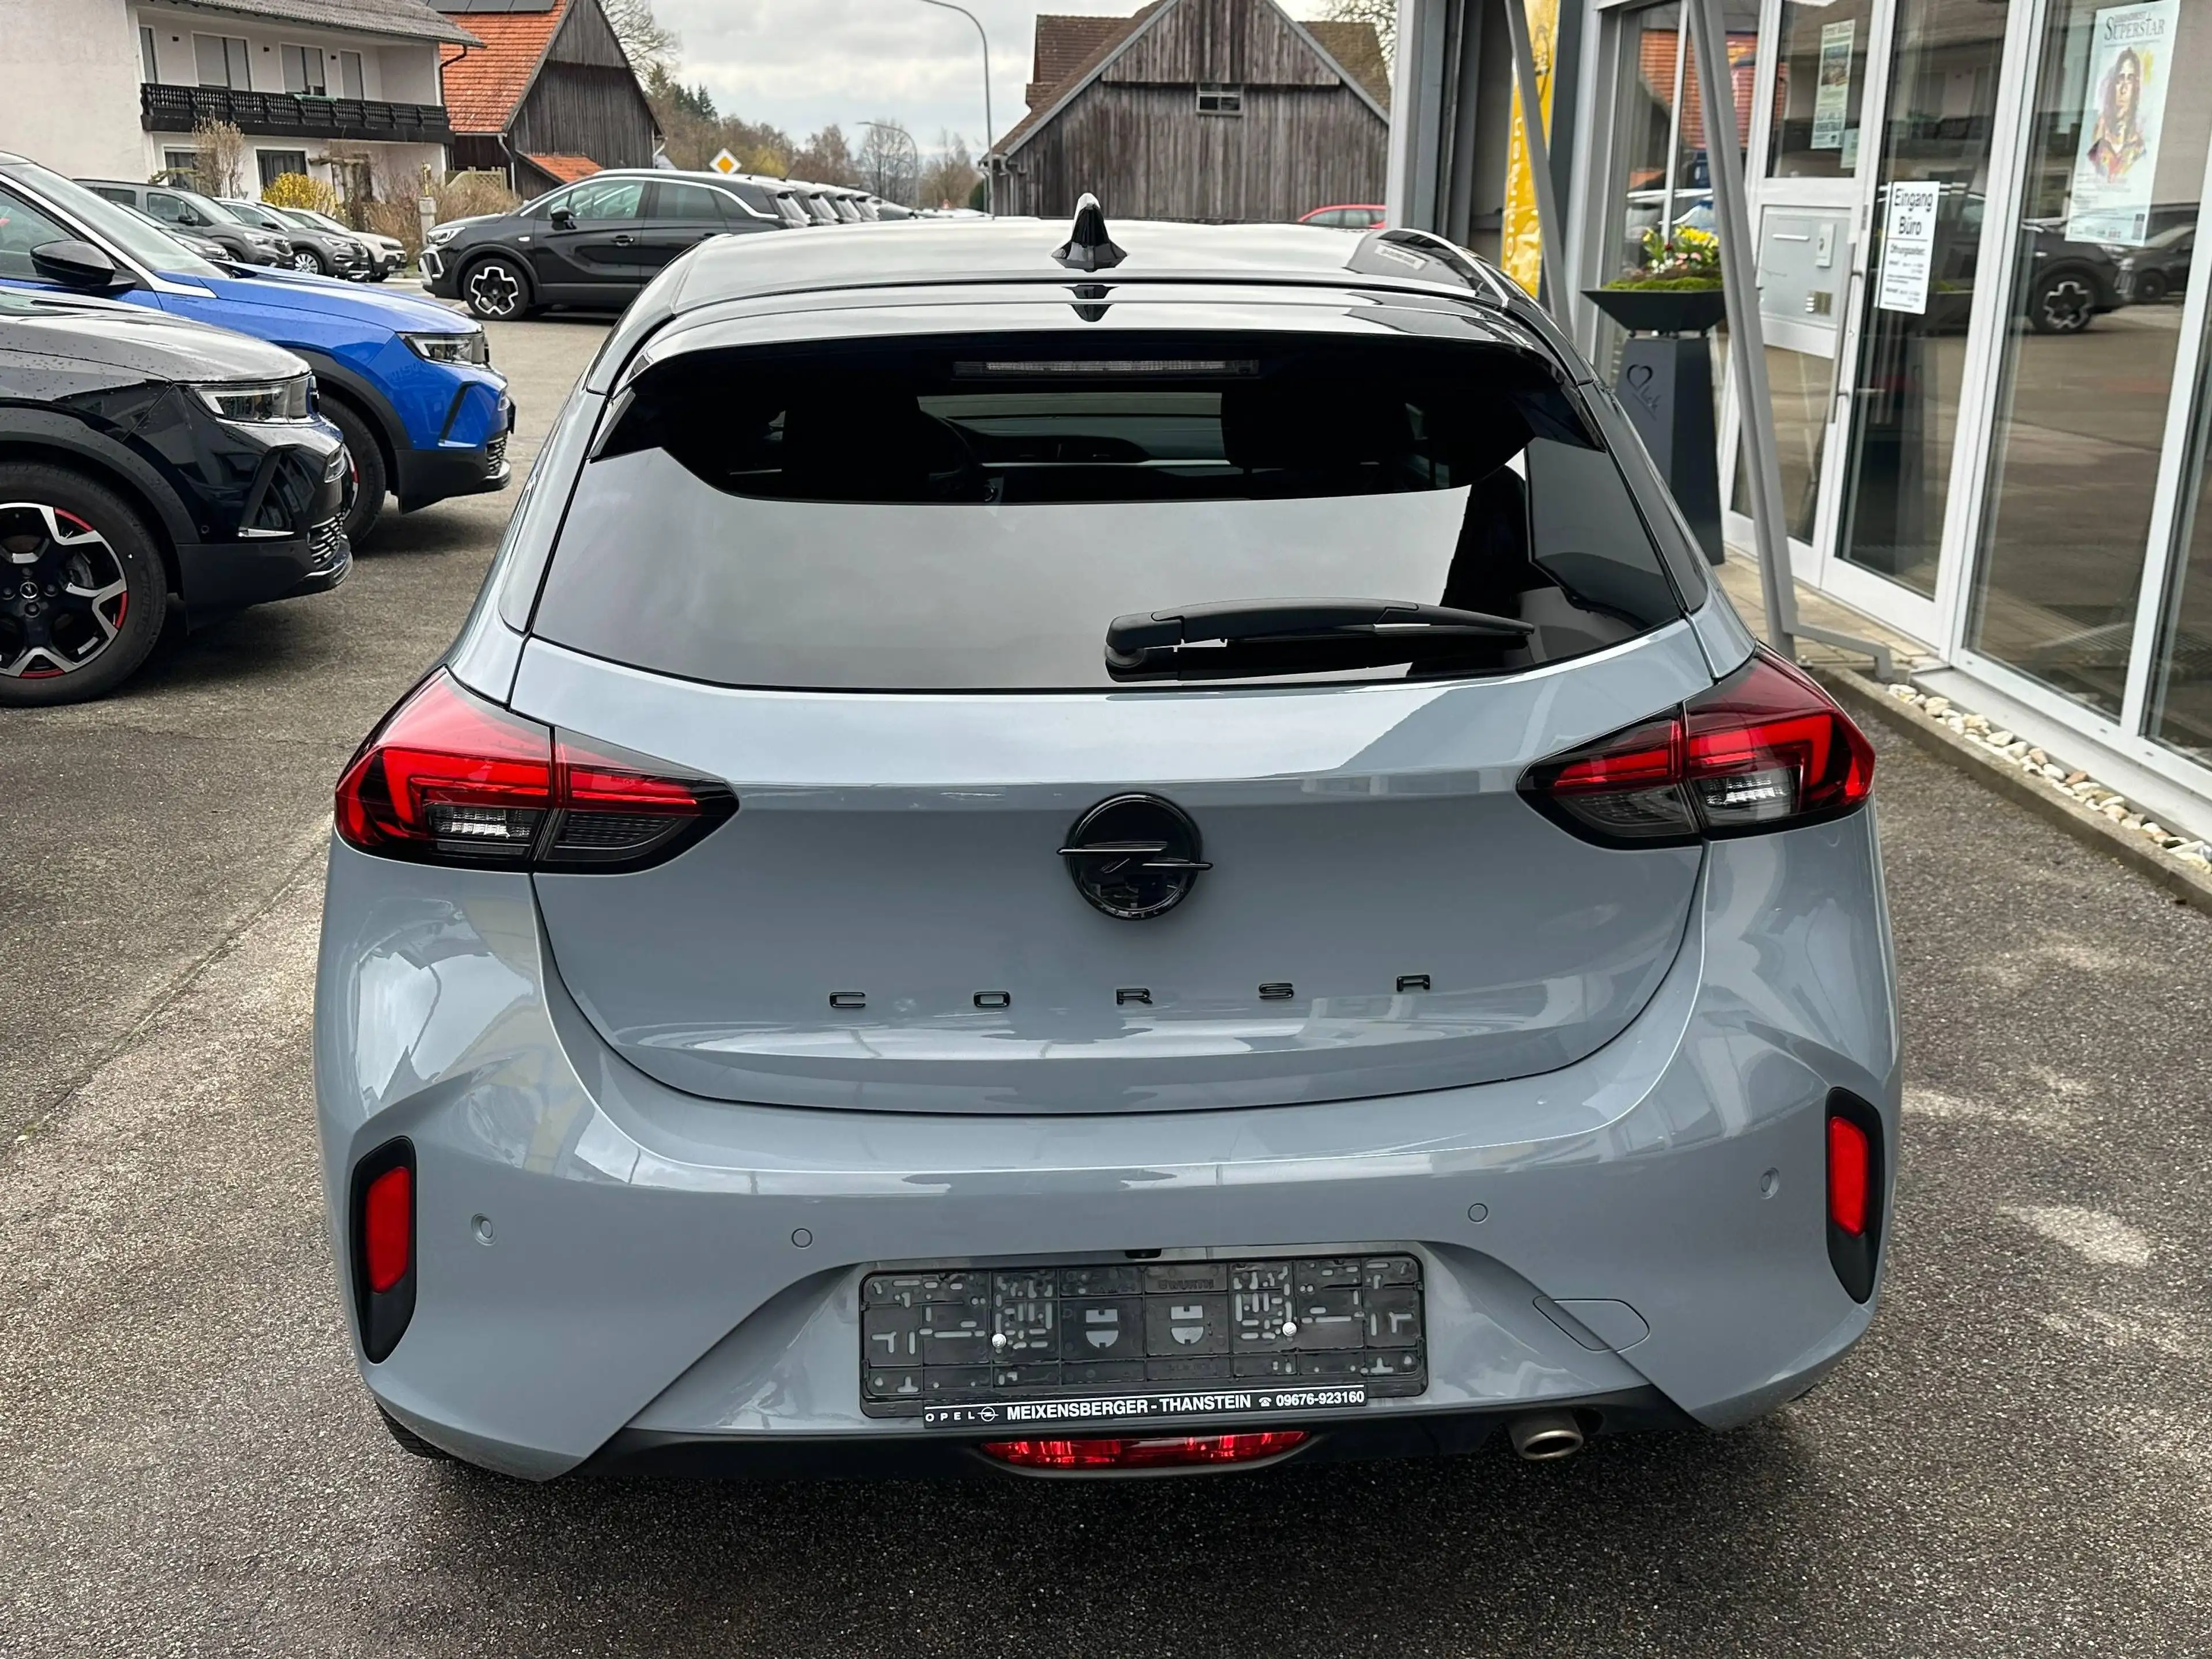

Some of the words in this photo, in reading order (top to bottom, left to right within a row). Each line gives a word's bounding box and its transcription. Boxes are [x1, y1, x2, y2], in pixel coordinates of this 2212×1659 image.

[1895, 188, 1933, 213] Eingang
[1899, 215, 1922, 235] Büro
[830, 974, 1430, 1008] CORSA
[925, 1411, 975, 1422] OPEL
[1007, 1399, 1149, 1421] MEIXENSBERGER
[1158, 1394, 1251, 1412] THANSTEIN
[1275, 1390, 1365, 1407] 09676-923160
